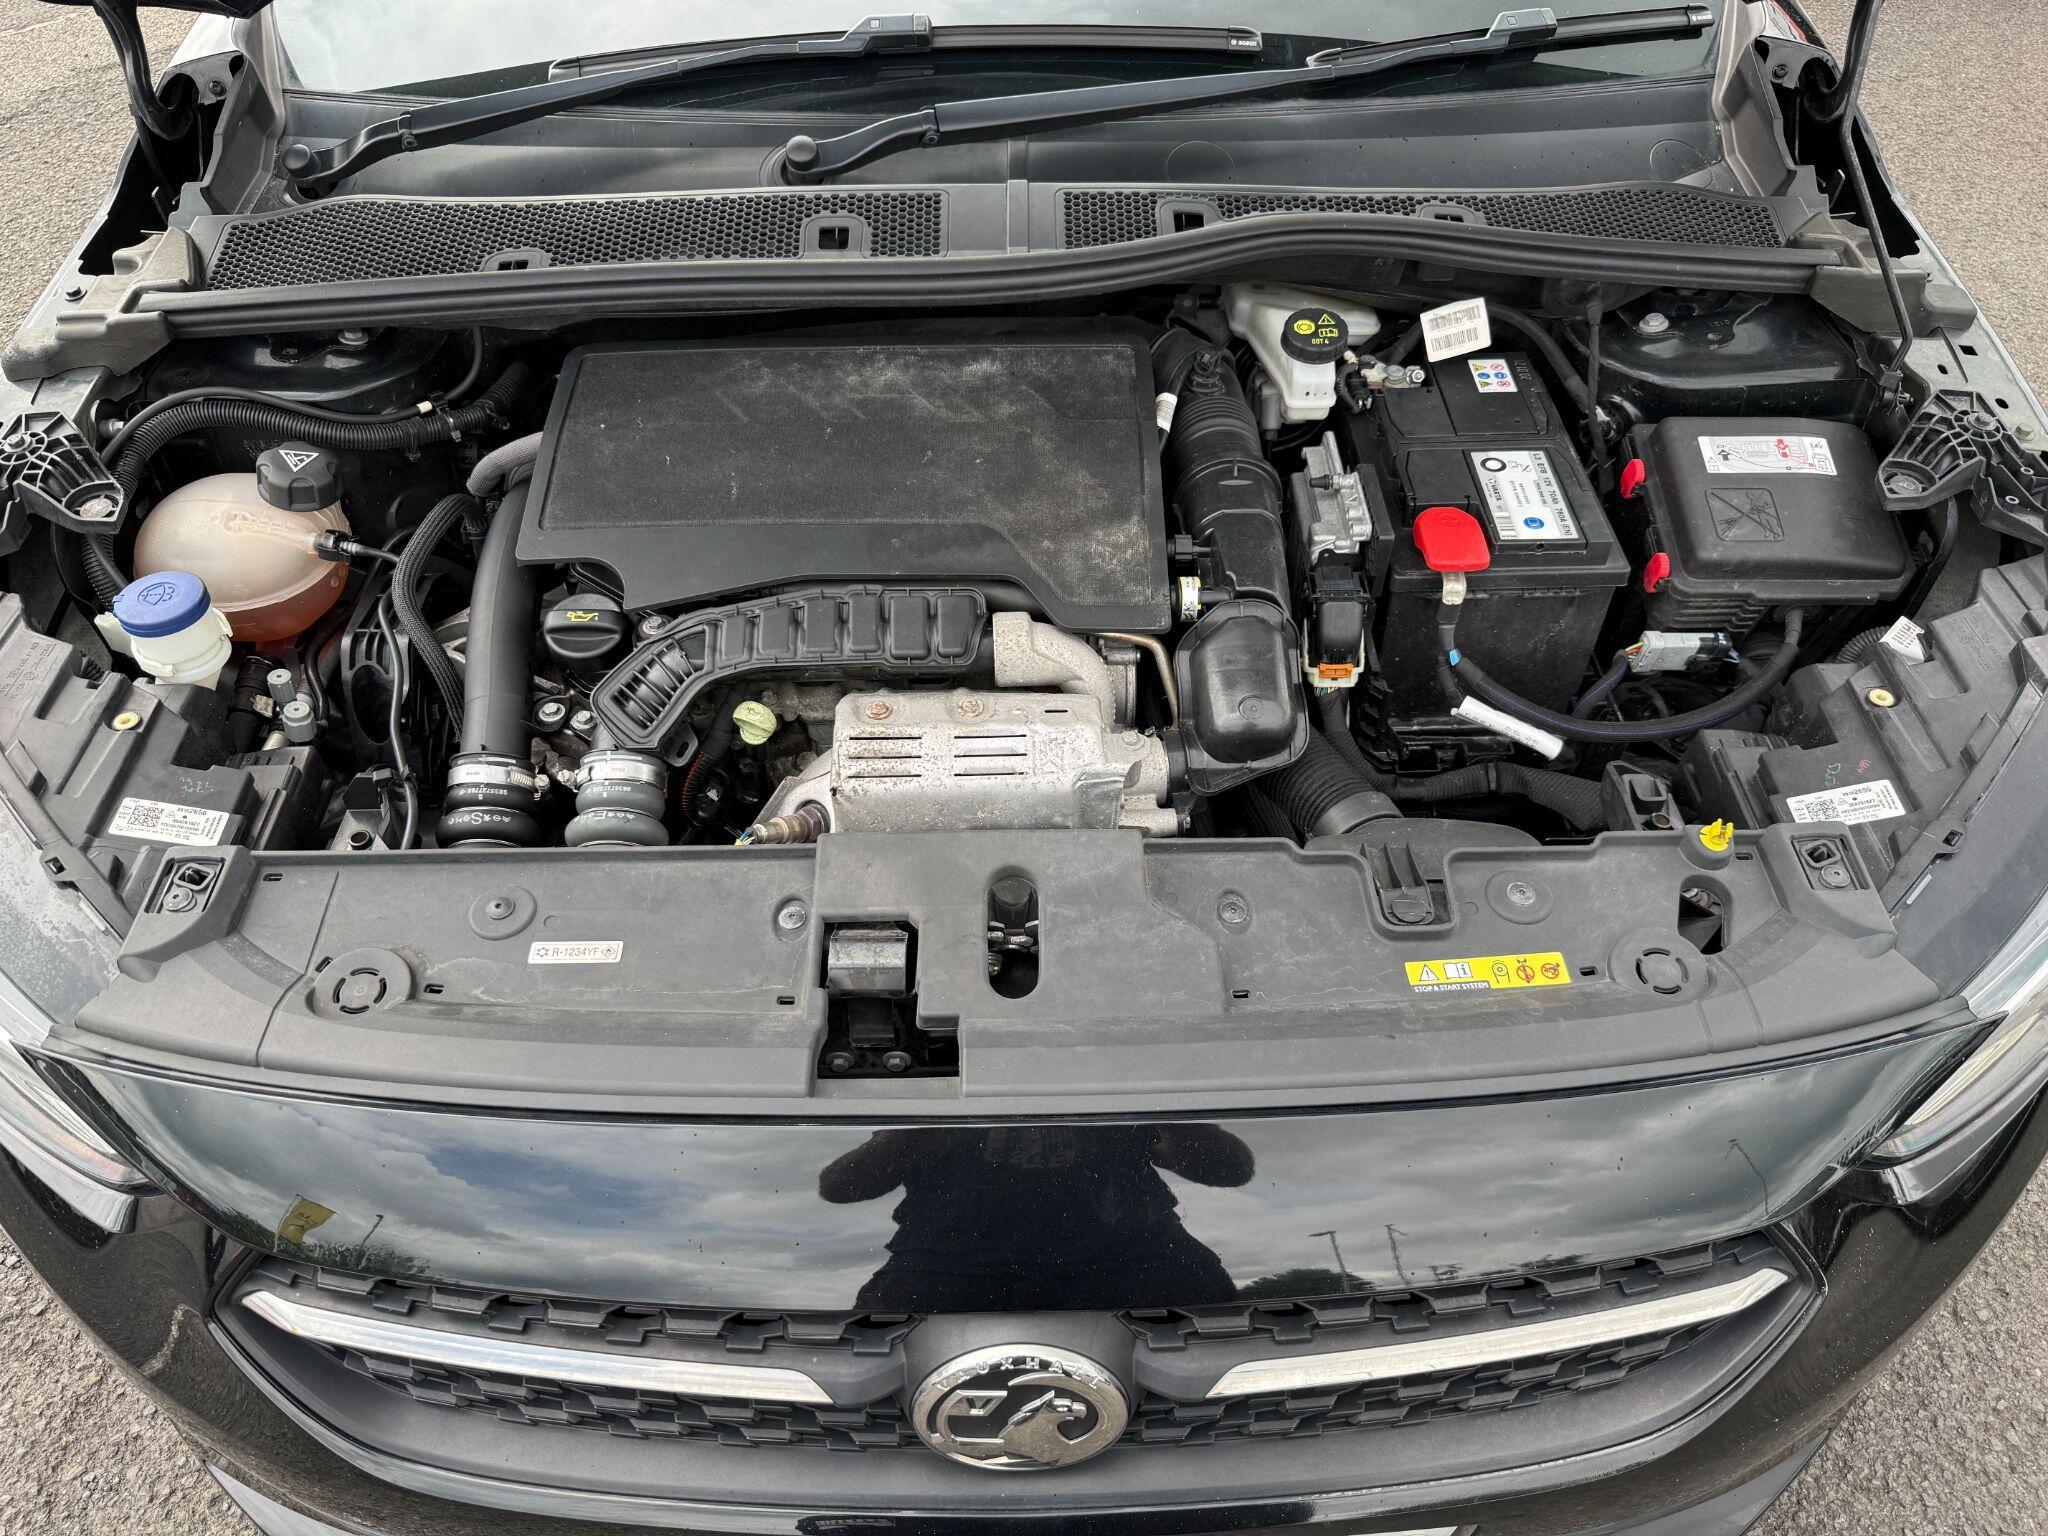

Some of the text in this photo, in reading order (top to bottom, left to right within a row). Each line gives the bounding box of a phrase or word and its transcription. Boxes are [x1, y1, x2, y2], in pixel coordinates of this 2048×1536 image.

[551, 946, 600, 957] R-1234YF
[1462, 982, 1489, 990] SYSTEM
[931, 1355, 1101, 1391] VAUXHALL
